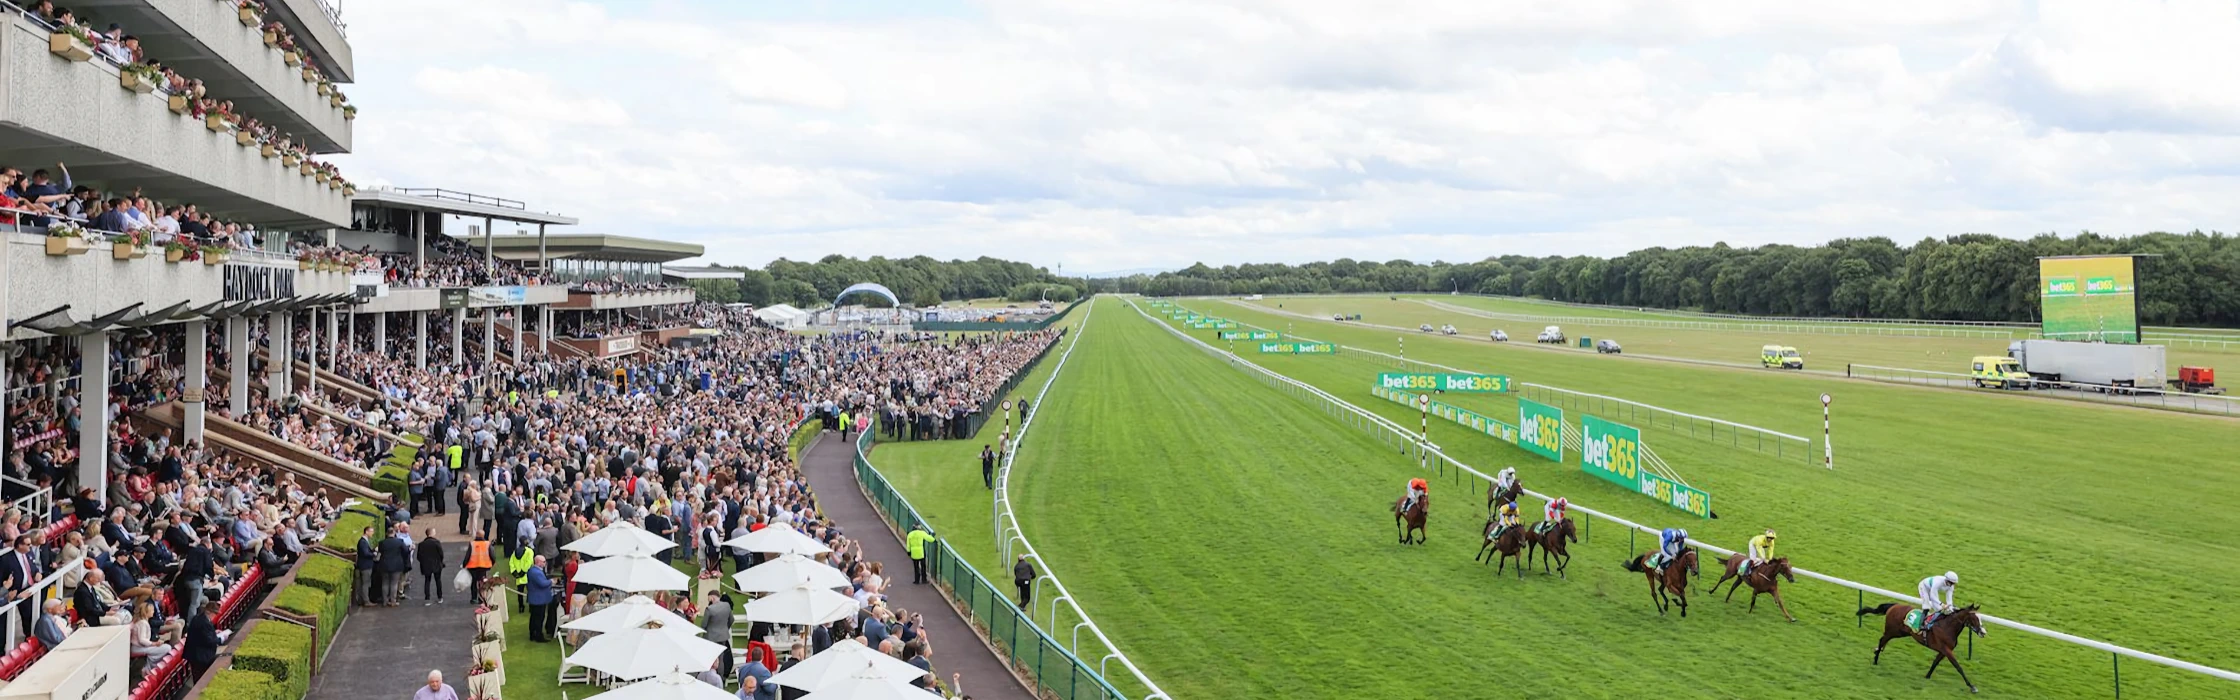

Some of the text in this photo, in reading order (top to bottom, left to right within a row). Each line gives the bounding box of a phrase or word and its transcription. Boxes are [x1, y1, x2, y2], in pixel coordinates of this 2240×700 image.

[223, 264, 295, 301] HAYDOCK PARK
[1262, 343, 1331, 352] bet365 bet365
[1383, 374, 1501, 391] bet365 bet365
[1520, 407, 1559, 453] bet365
[1583, 425, 1636, 479] bet365
[1641, 472, 1706, 517] bet365 bet365
